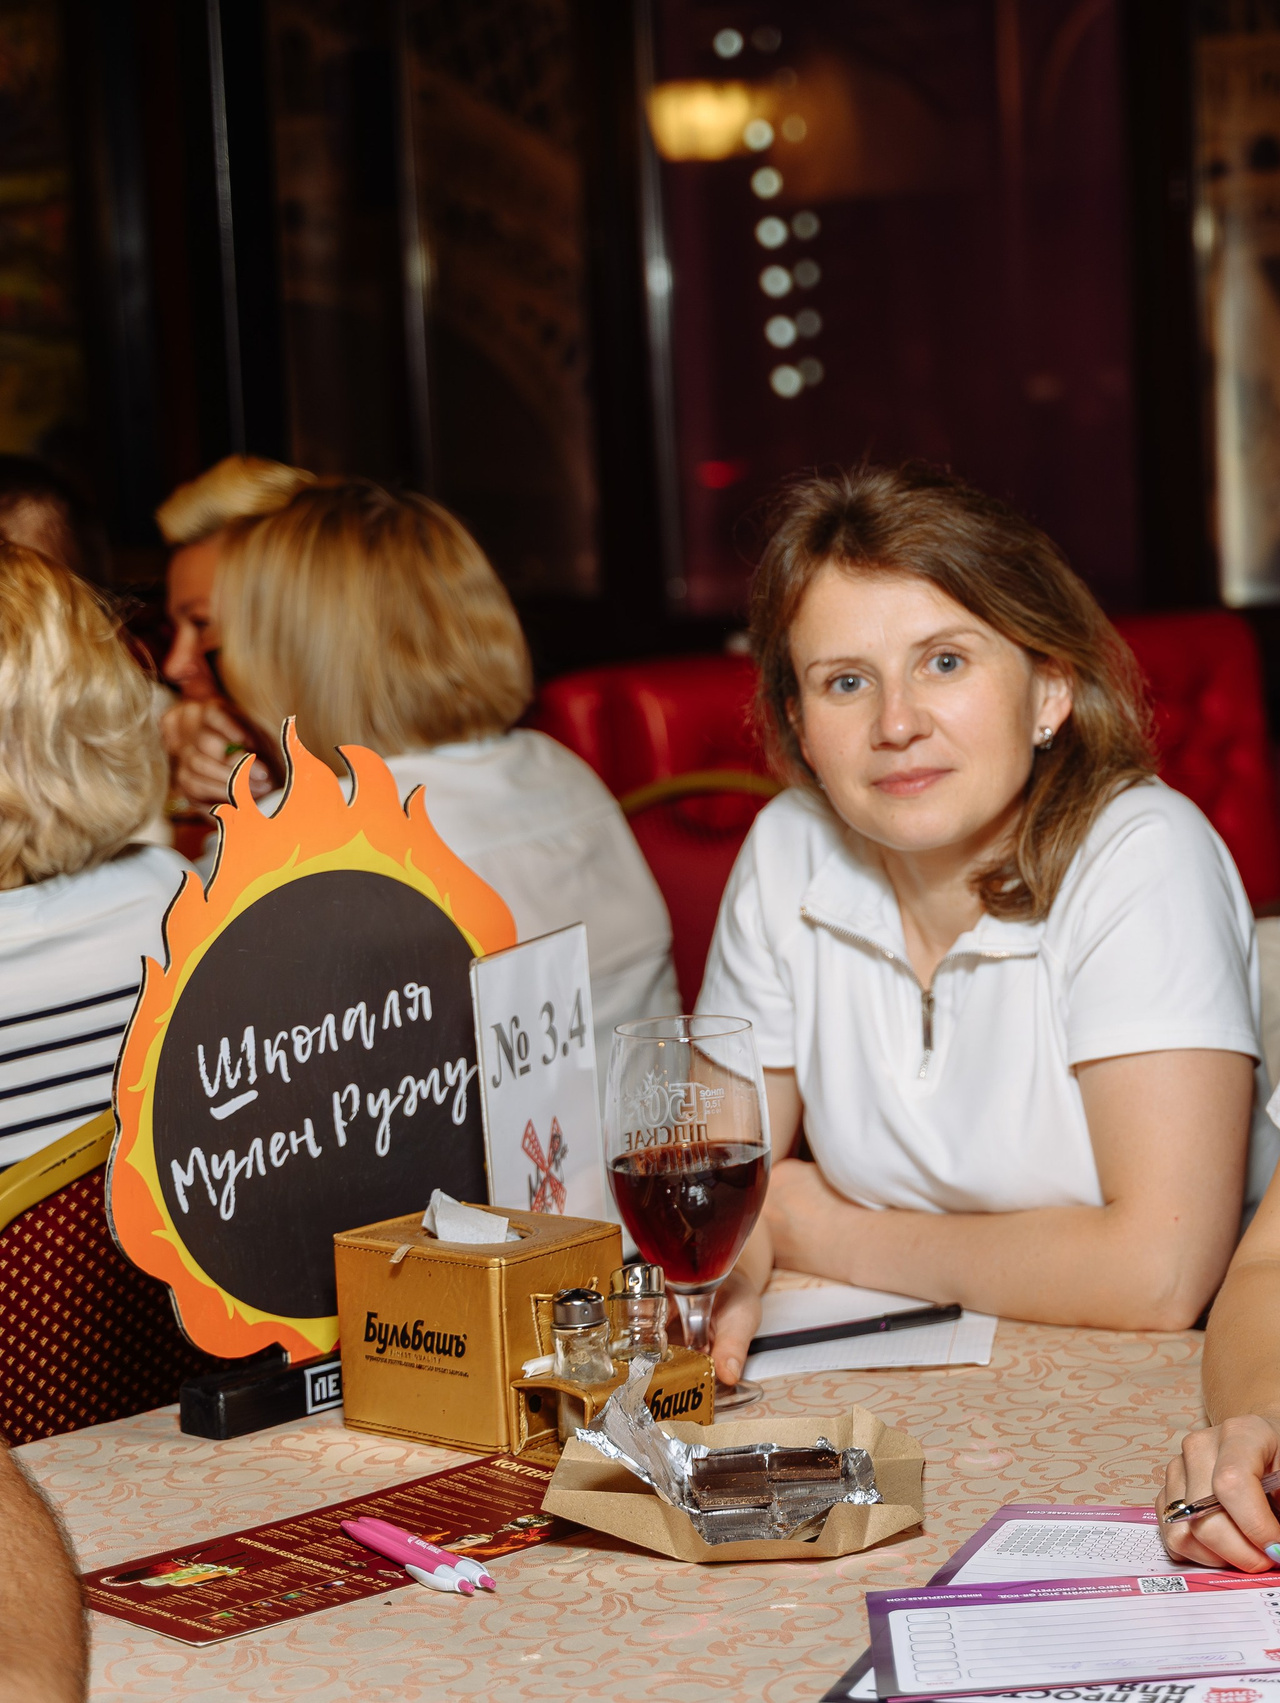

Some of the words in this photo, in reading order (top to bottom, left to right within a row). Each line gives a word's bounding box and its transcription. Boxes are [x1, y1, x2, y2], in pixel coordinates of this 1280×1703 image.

[540, 987, 586, 1065] 3.4
[170, 1117, 323, 1221] Мулен
[489, 1458, 554, 1481] КОКТЕЙ
